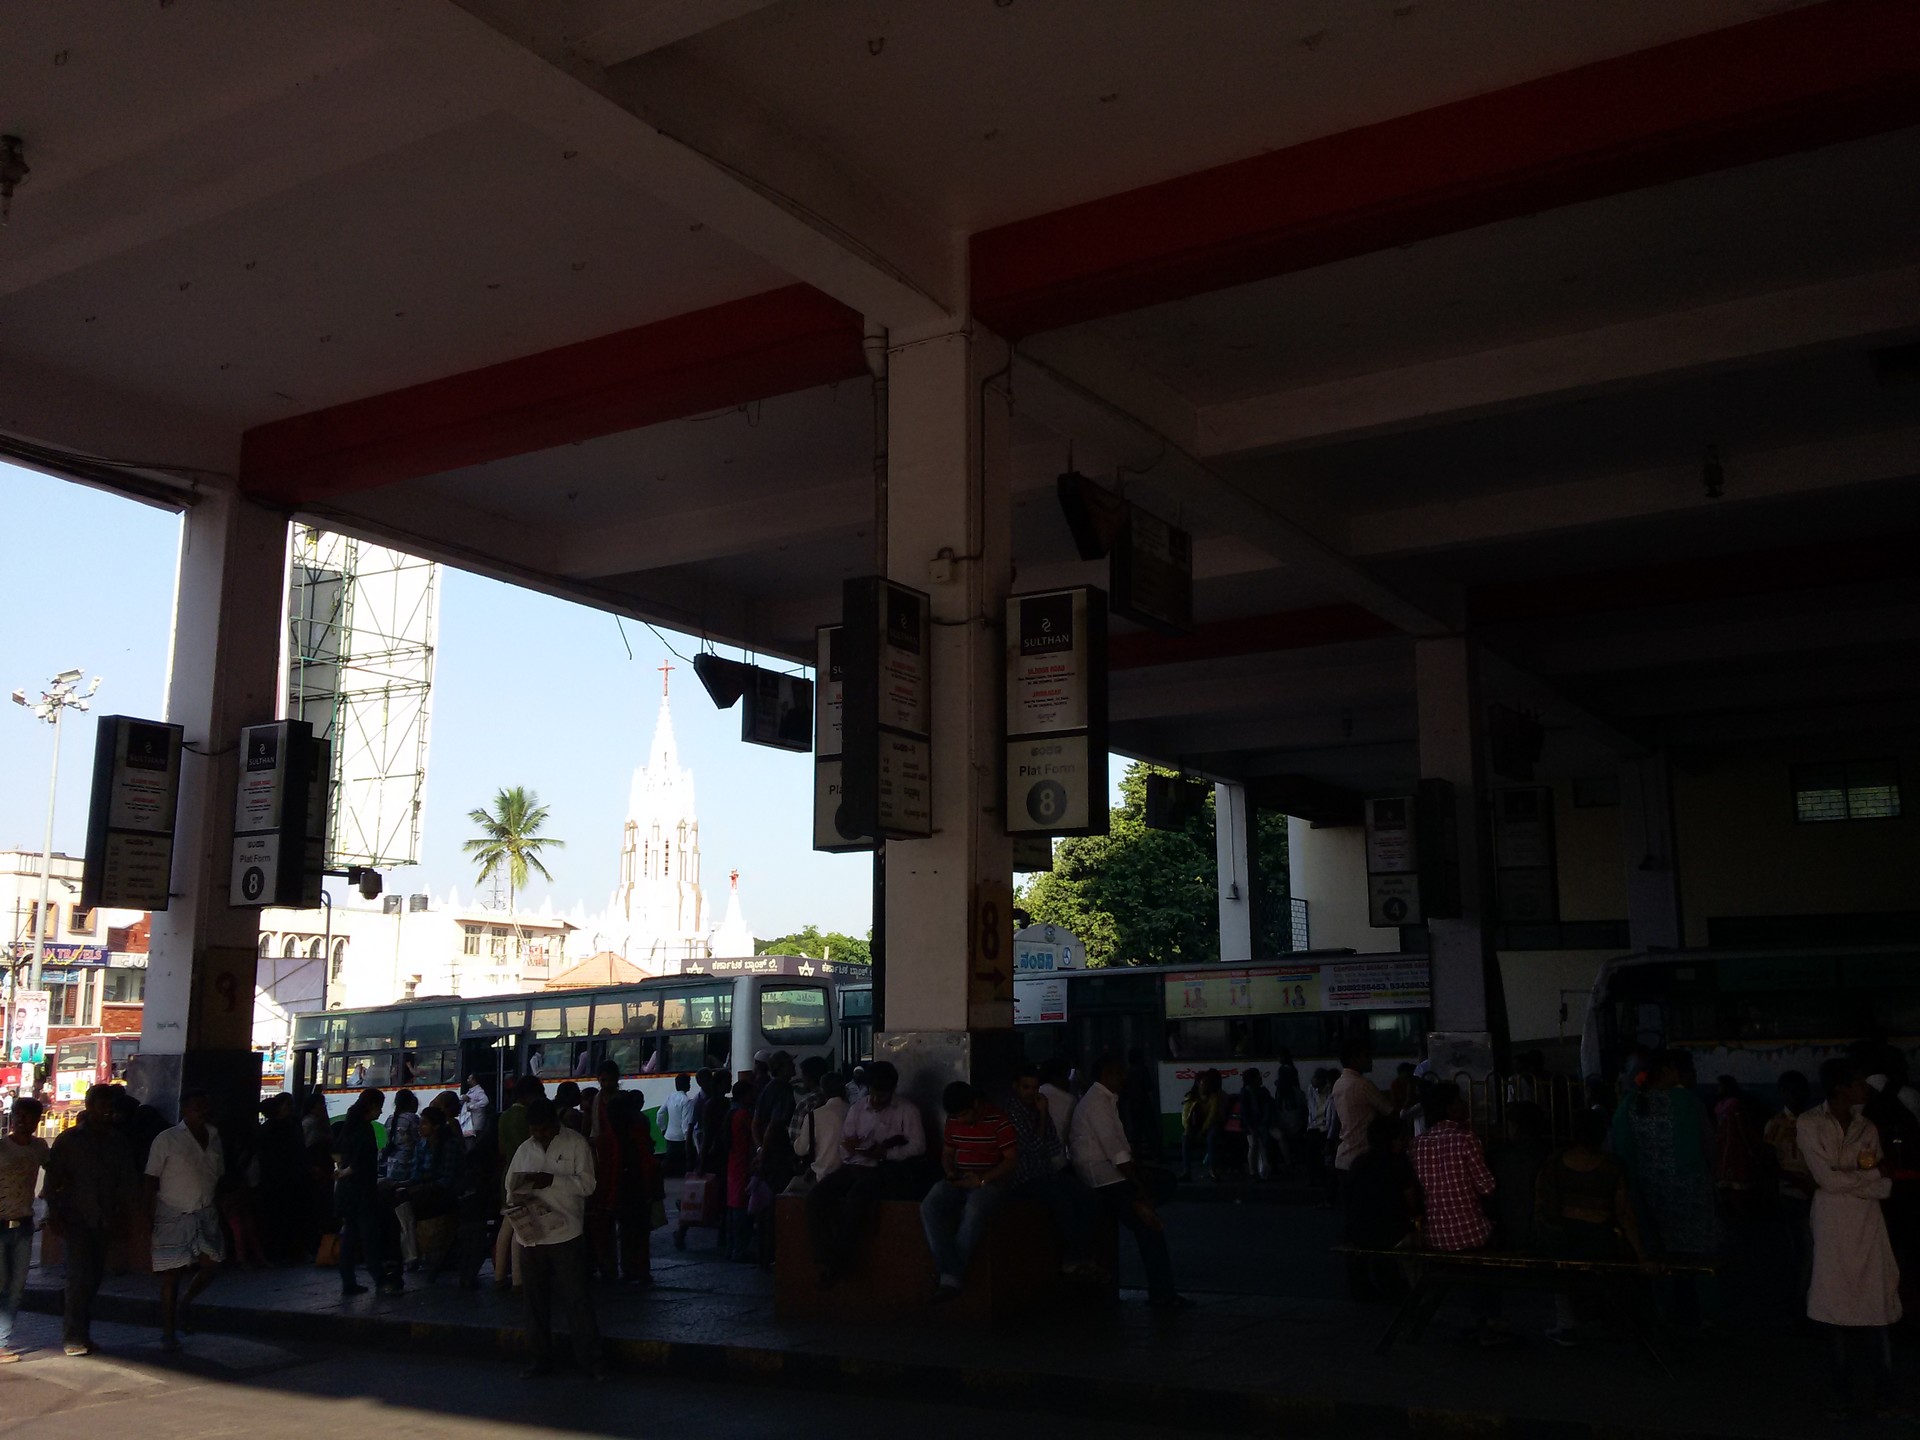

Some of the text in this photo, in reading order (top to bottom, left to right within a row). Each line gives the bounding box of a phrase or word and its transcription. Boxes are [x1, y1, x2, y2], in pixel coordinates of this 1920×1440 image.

[1024, 635, 1070, 648] SULTHAN
[249, 757, 275, 767] SULTHAN
[1019, 764, 1075, 777] Plat Form
[1040, 789, 1055, 815] 8
[240, 854, 271, 864] Plat Form
[248, 873, 259, 894] 8
[1391, 902, 1400, 916] 4
[982, 901, 1000, 960] 8
[58, 947, 102, 960] TRAVELS
[215, 971, 237, 1013] 9
